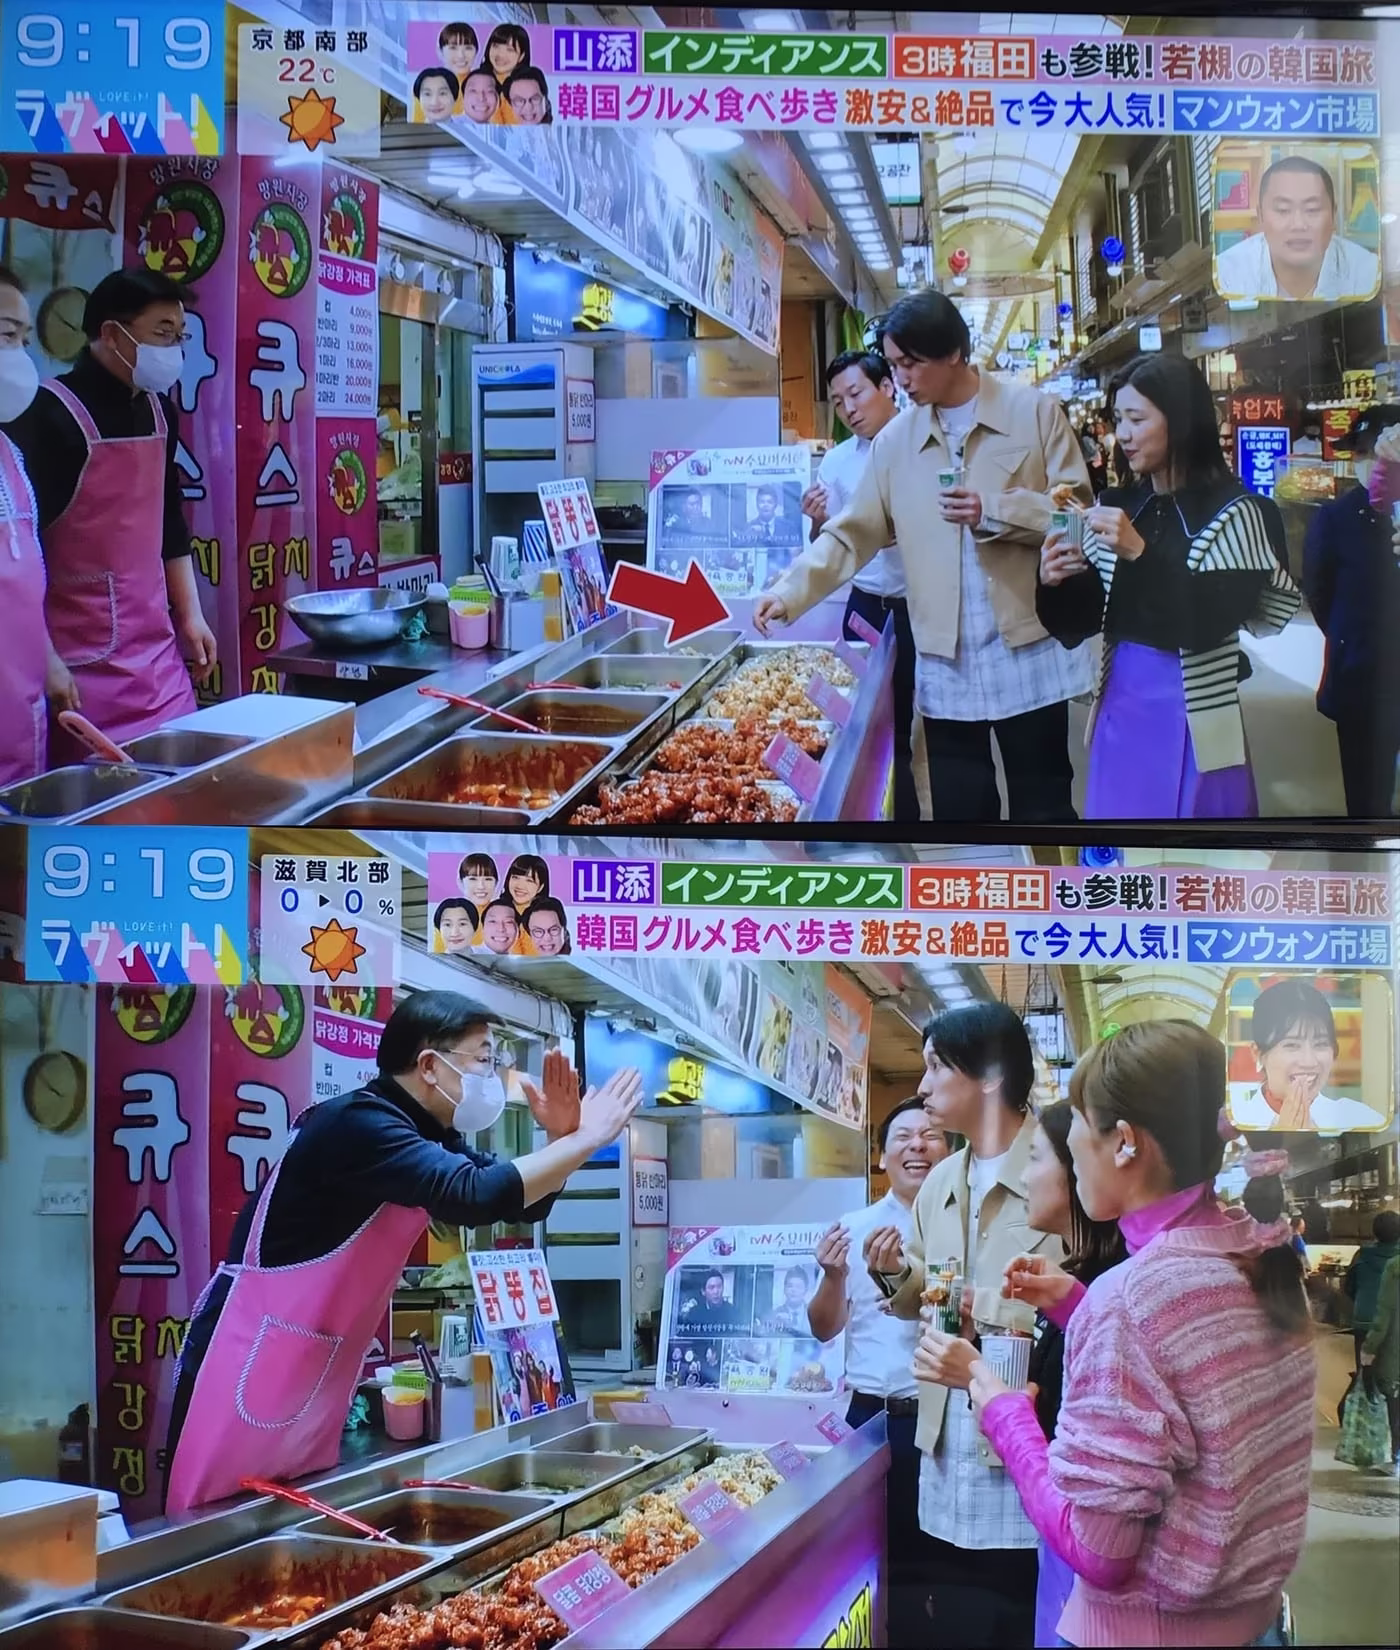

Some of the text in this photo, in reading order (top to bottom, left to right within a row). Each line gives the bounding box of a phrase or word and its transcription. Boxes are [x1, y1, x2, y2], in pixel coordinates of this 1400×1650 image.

[17, 14, 212, 70] 9:19
[251, 28, 368, 53] 京都南部
[559, 33, 632, 72] 山添
[649, 35, 882, 75] インディアンス
[901, 41, 1030, 77] 3時福田
[1161, 44, 1376, 84] 若槻の韓国旅
[15, 89, 200, 140] ラヴィット!
[558, 82, 837, 123] 韓国グルメ食べ歩き
[845, 87, 994, 127] 激安&絶品
[1178, 95, 1376, 132] マンウォン市場
[258, 178, 308, 210] 망원시장
[346, 270, 371, 289] 가격표
[329, 537, 375, 581] 큐스
[42, 844, 237, 900] 9:19
[274, 858, 390, 884] 滋賀北部
[577, 864, 650, 903] 山添
[667, 865, 900, 906] インディアンス
[917, 872, 1046, 909] 3時福田
[1175, 876, 1388, 916] 若槻の韓国旅
[280, 888, 394, 916] 0 0 %
[41, 919, 222, 969] ラヴィット!
[577, 914, 854, 955] 韓国グルメ食べ歩き
[861, 920, 1010, 958] 激安&絶品
[1193, 925, 1389, 963] マンウォン市場
[316, 1021, 348, 1043] 닭강정
[316, 1081, 341, 1096] 반마리
[113, 1071, 190, 1277] 큐스
[639, 1195, 663, 1211] 5,000원
[476, 1268, 553, 1322] 닭똥집
